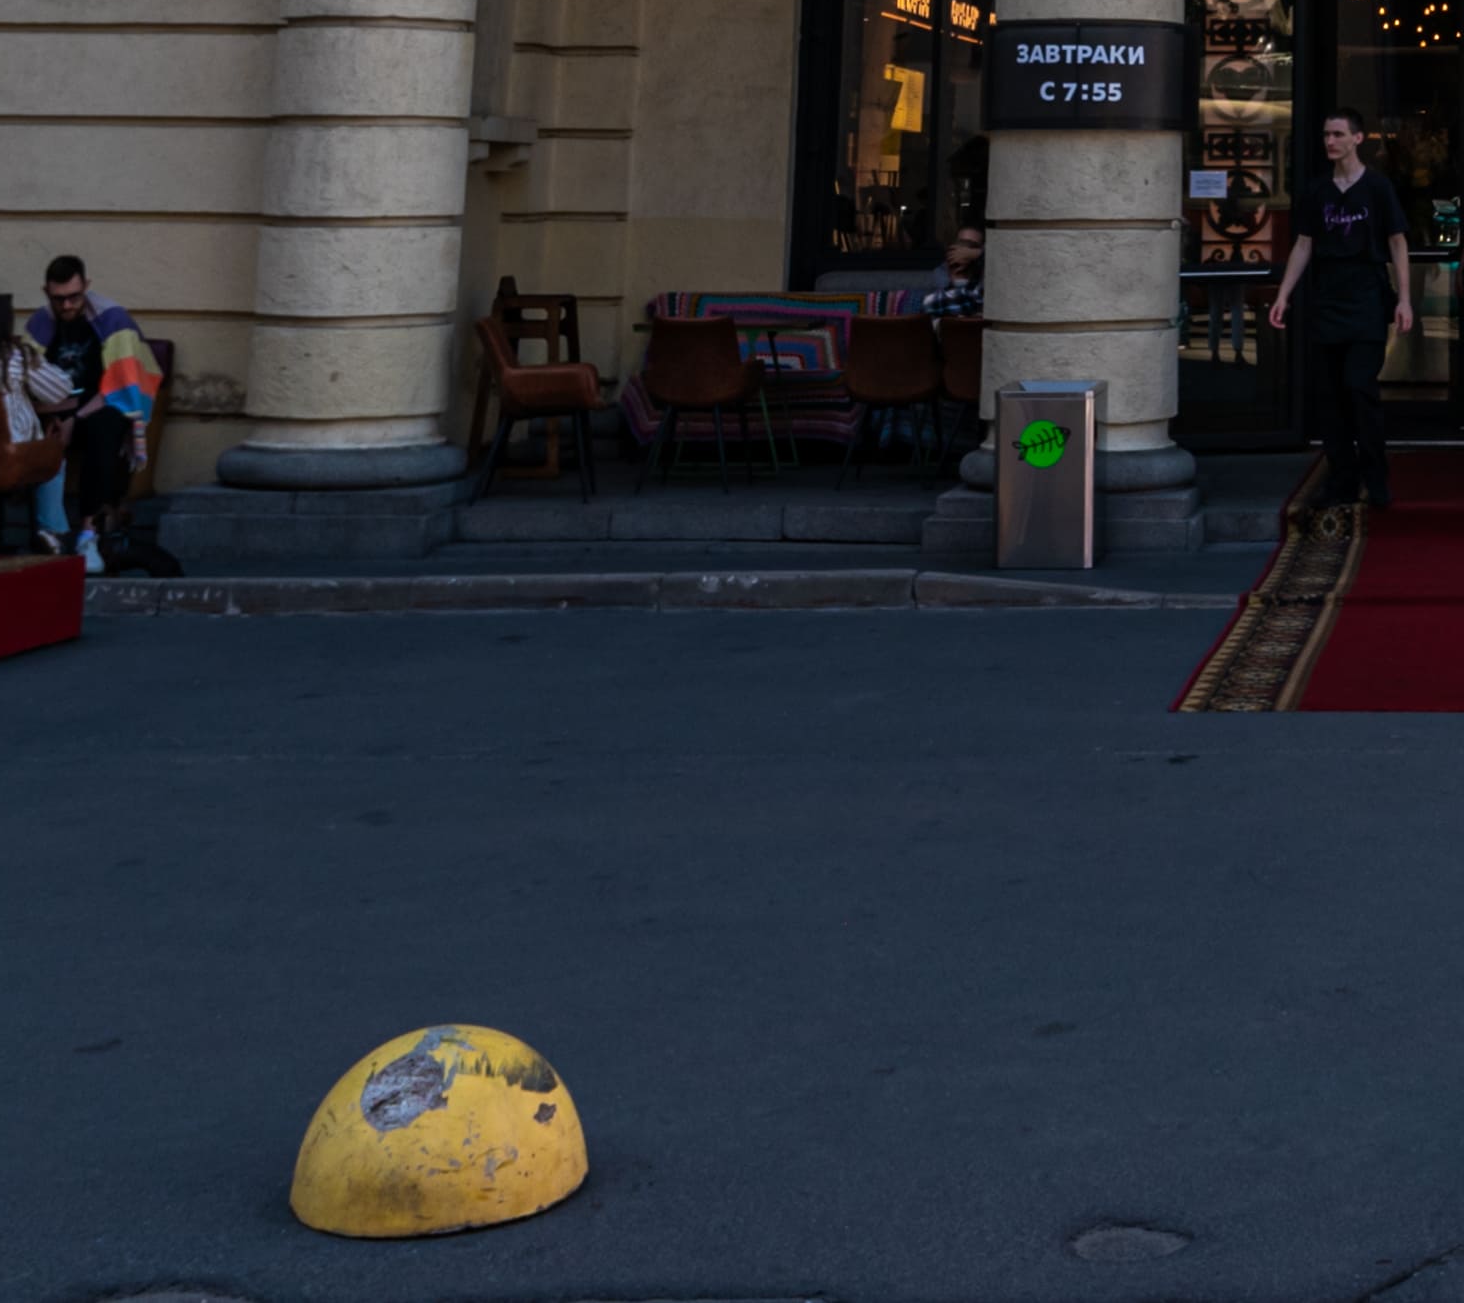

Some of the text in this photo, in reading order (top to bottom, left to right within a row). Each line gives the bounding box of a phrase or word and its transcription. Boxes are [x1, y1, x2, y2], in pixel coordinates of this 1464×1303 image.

[1015, 43, 1146, 66] ЗАВТРАКИ
[1039, 81, 1123, 102] С 7:55
